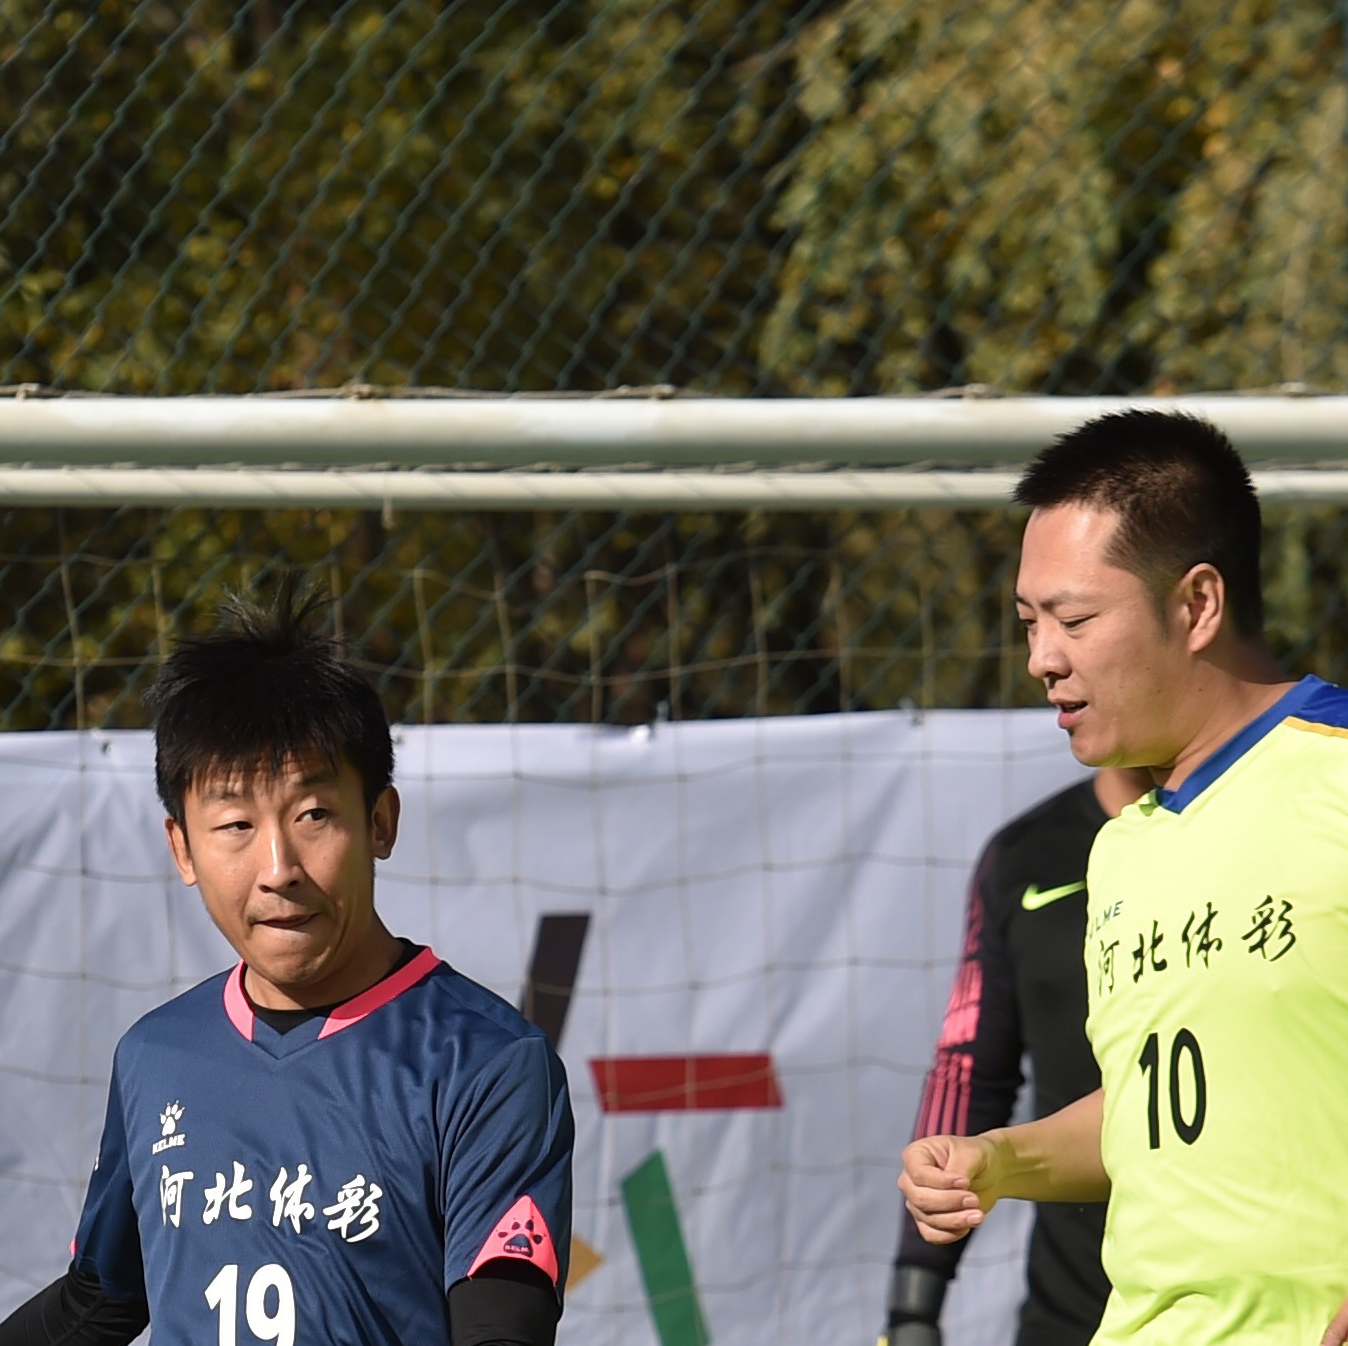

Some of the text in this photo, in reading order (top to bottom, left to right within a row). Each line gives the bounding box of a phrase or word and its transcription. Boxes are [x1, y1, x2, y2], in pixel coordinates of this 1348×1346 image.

[1098, 895, 1297, 997] 河北体彩
[1138, 1028, 1206, 1150] 10
[152, 1133, 186, 1155] KELME
[159, 1161, 384, 1243] 河北体彩
